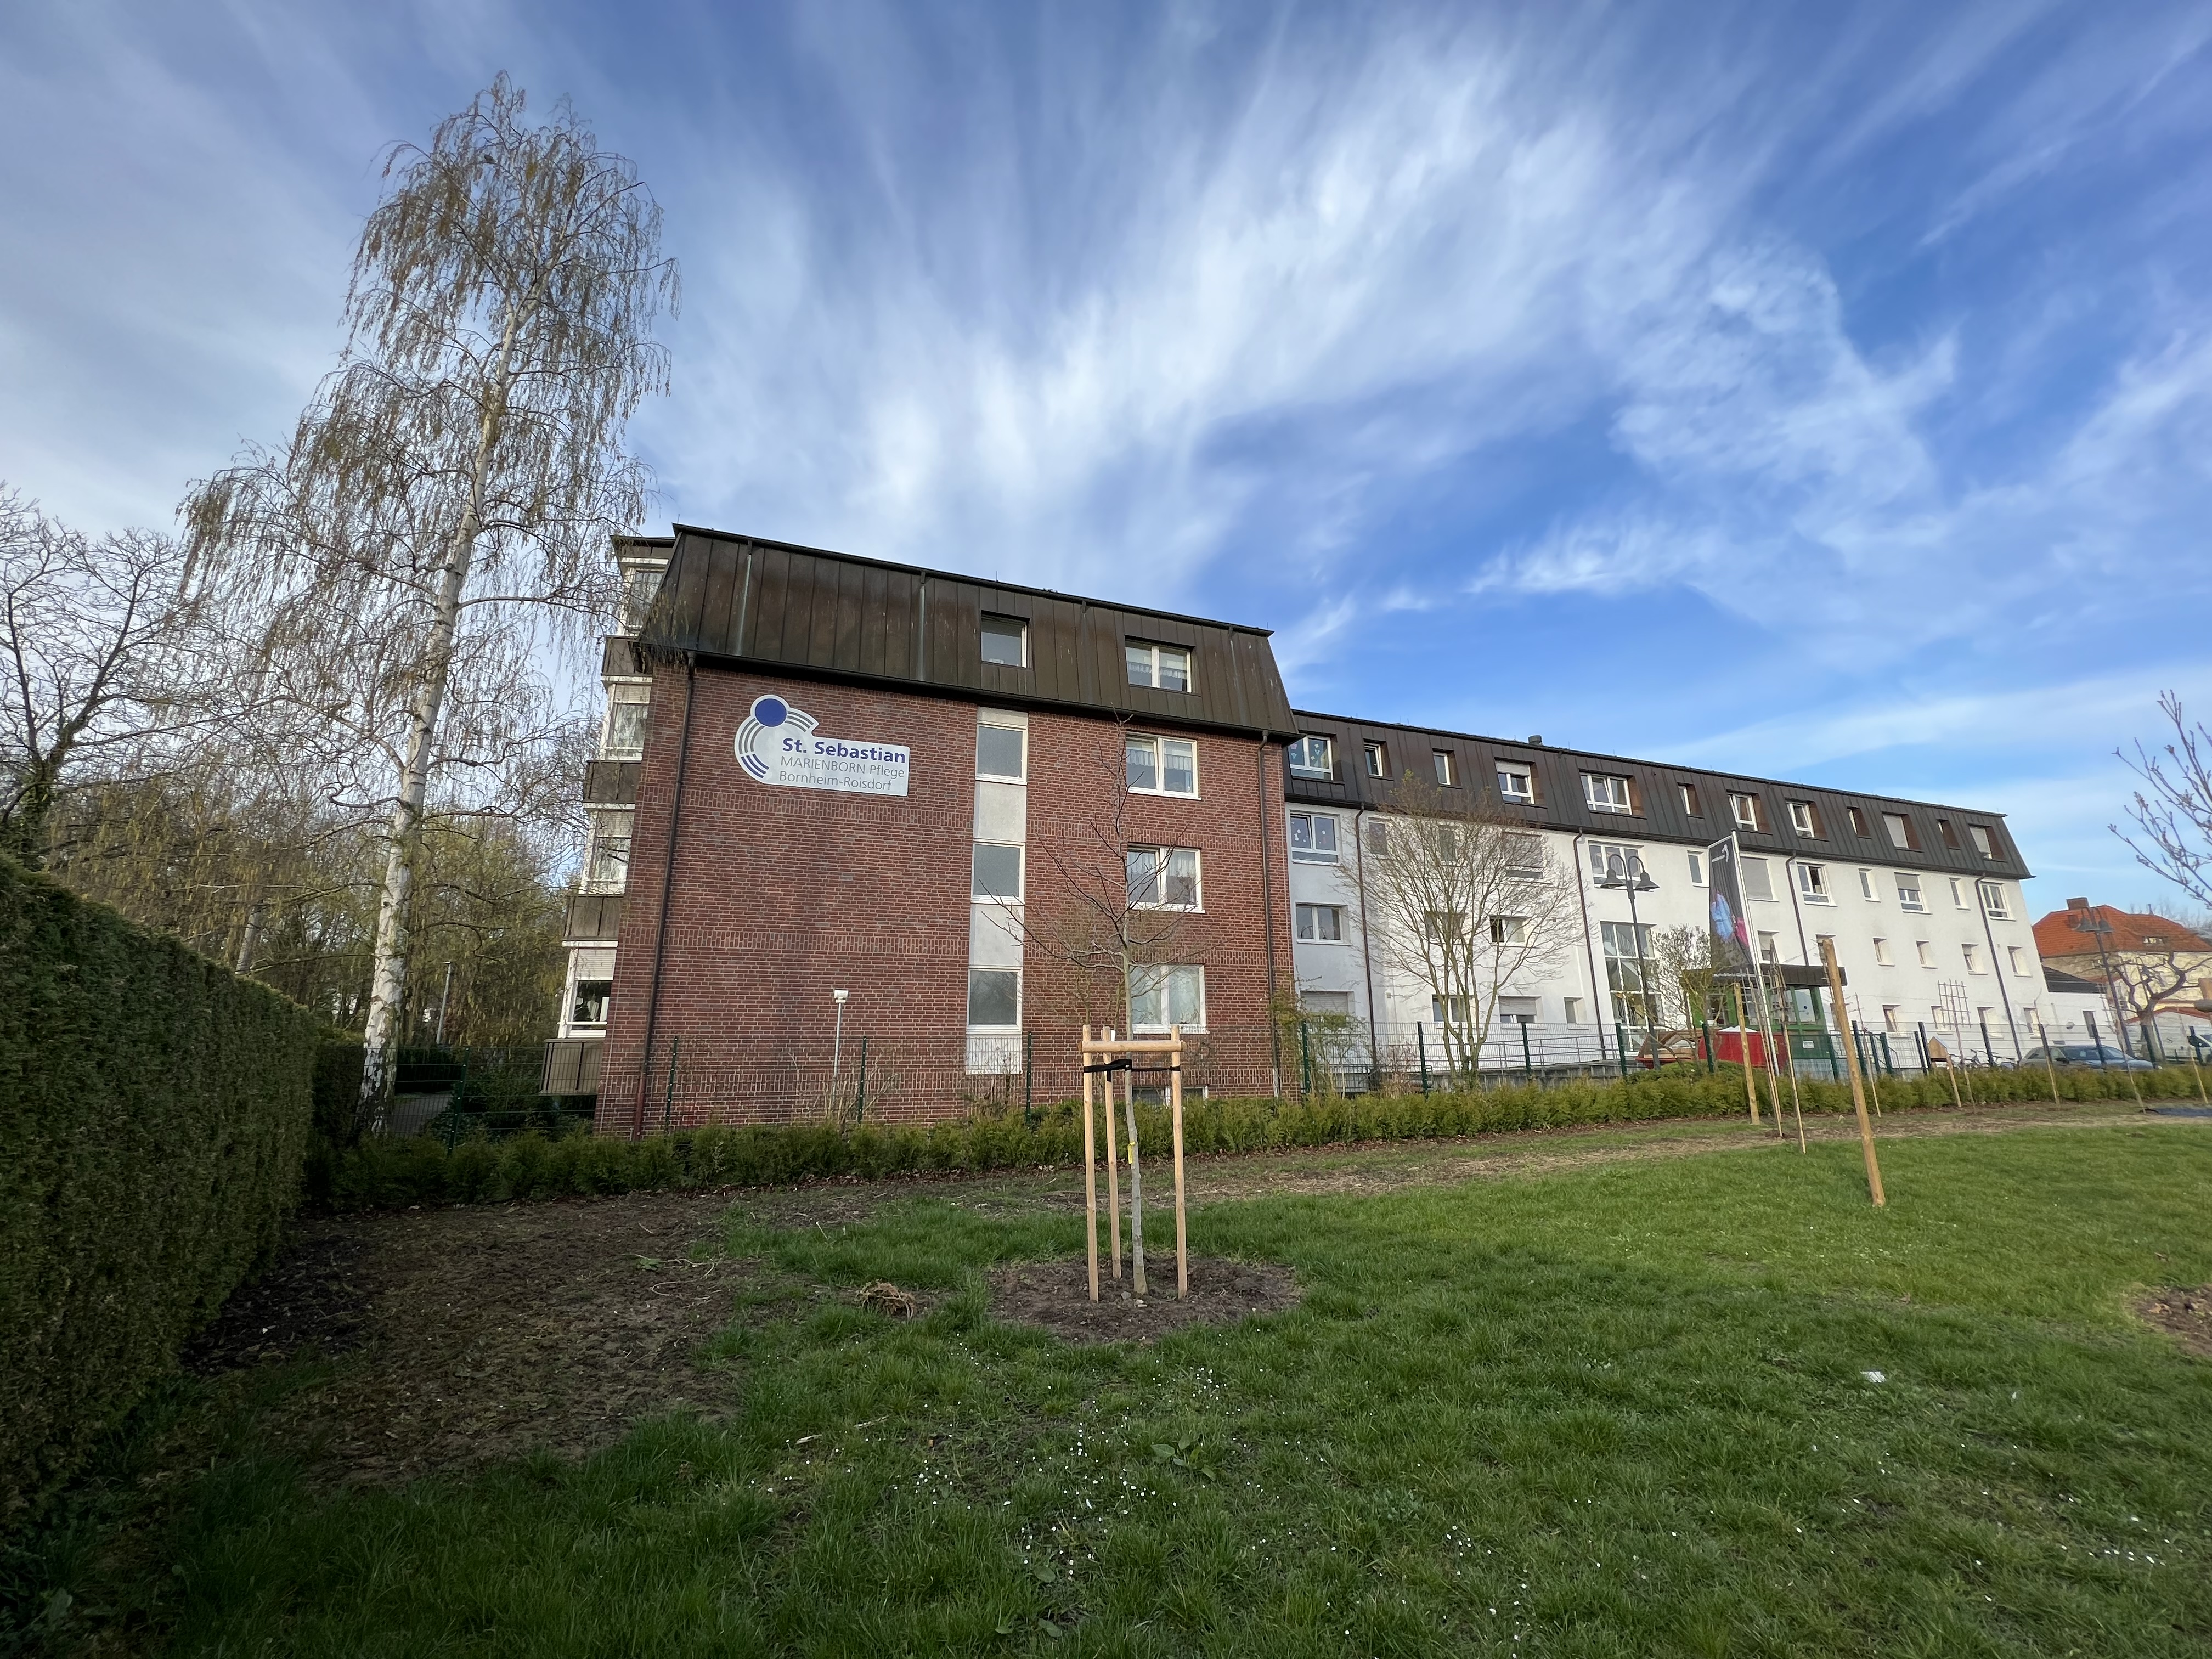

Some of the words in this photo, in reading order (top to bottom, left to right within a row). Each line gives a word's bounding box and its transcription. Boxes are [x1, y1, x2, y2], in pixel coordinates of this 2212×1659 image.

[782, 738, 807, 753] St.
[814, 741, 905, 763] Sebastian
[781, 757, 865, 774] MARIENBORN
[870, 765, 905, 779] Pflege
[780, 771, 892, 790] Bornheim-Roisdorf
